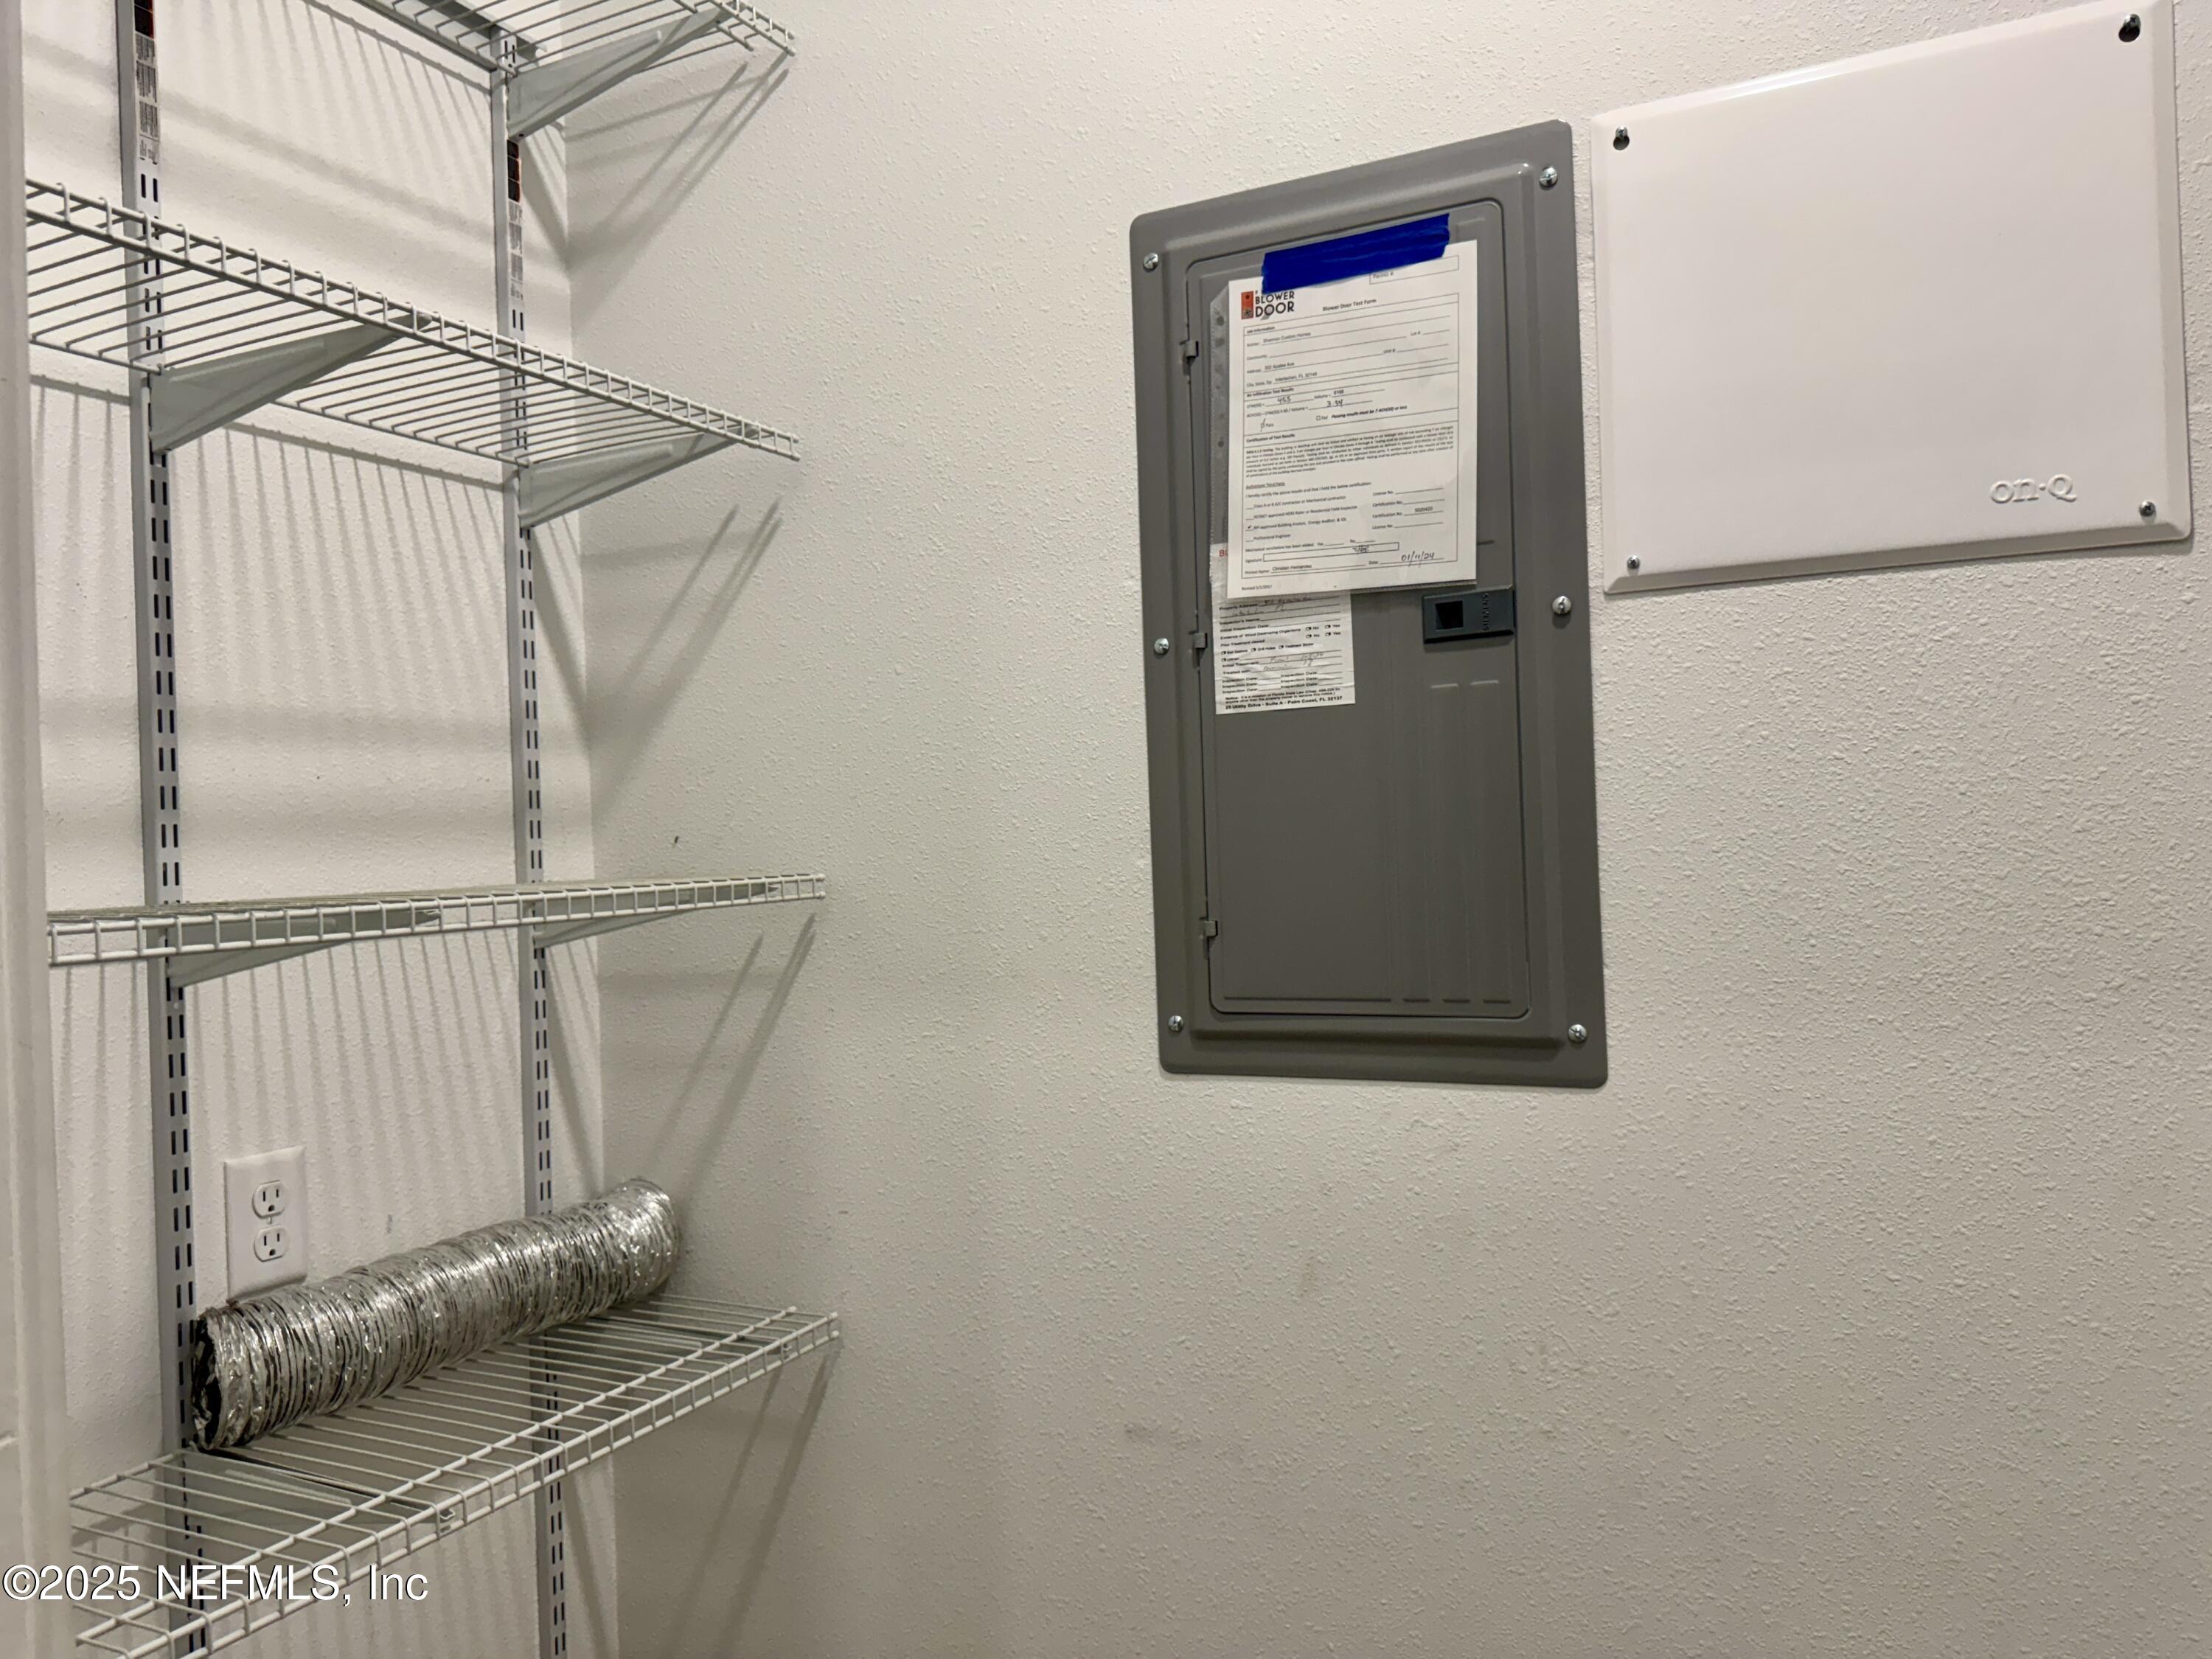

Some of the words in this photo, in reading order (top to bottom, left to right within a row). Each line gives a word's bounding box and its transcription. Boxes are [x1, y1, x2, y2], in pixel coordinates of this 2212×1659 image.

[1255, 291, 1295, 305] BLOWER
[1255, 301, 1294, 317] DOOR
[1323, 304, 1339, 312] Blower
[1277, 396, 1291, 404] 455
